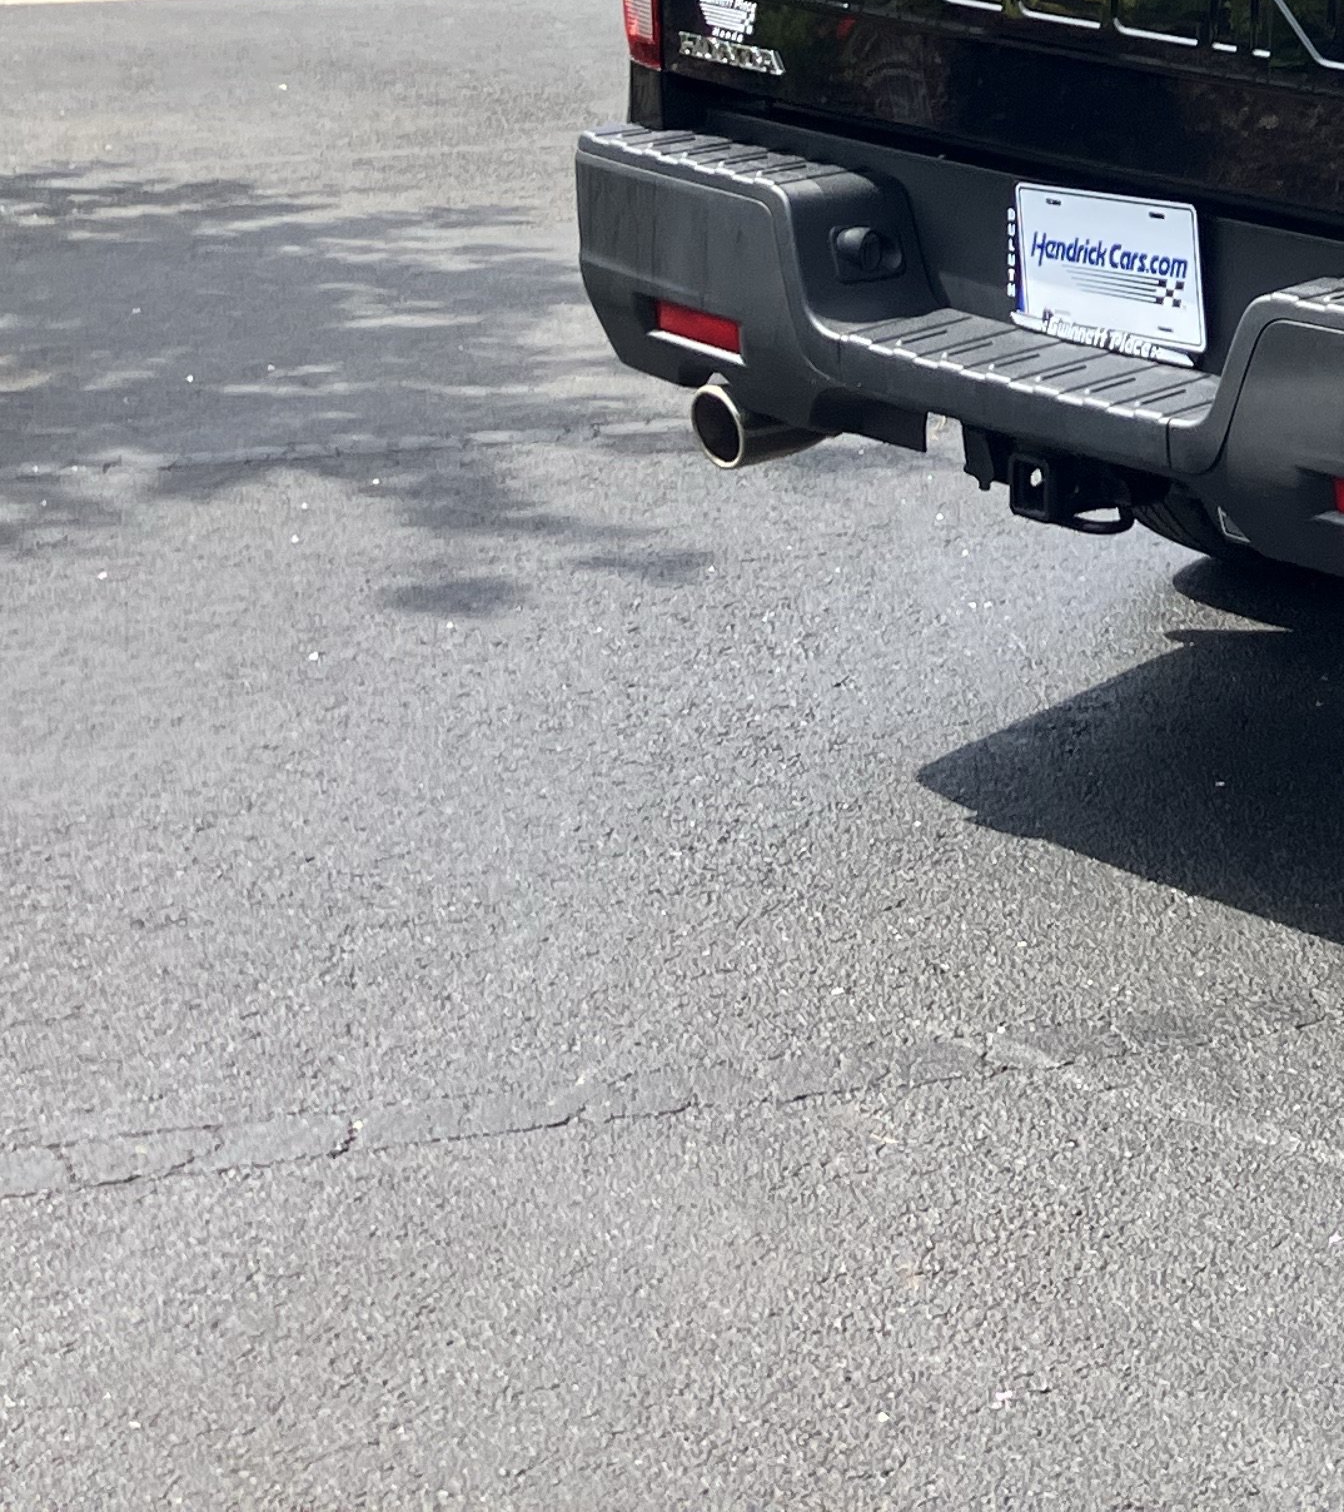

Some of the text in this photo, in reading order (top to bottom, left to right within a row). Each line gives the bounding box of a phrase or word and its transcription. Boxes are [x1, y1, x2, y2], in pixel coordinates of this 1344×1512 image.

[679, 31, 785, 75] HONDA
[1007, 207, 1016, 297] DULUTH
[1047, 317, 1152, 358] Gwinnett Place
